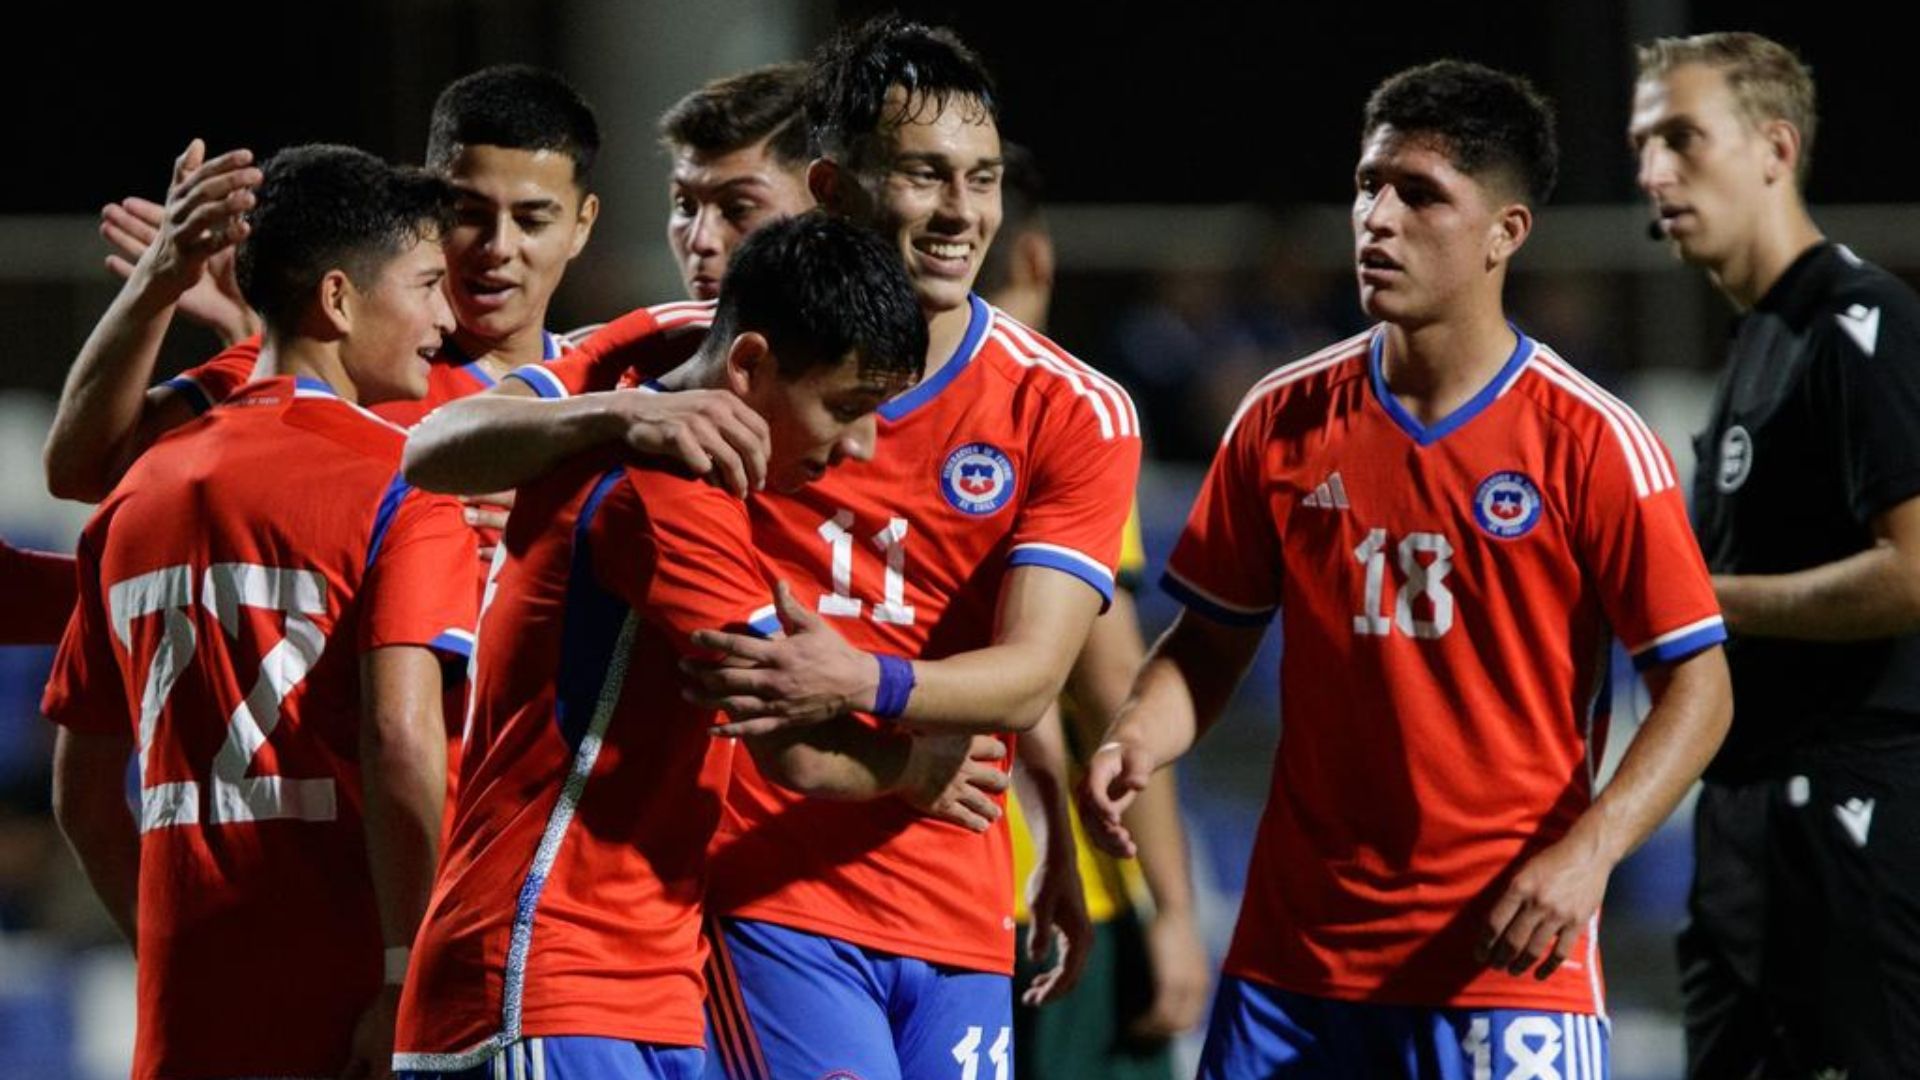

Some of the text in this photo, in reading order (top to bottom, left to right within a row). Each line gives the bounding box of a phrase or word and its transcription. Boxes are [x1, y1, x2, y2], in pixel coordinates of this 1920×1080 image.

[817, 508, 915, 626] 11
[1353, 528, 1454, 639] 18
[108, 562, 337, 834] 22
[952, 1026, 1010, 1080] 11
[1463, 1016, 1562, 1080] 18
